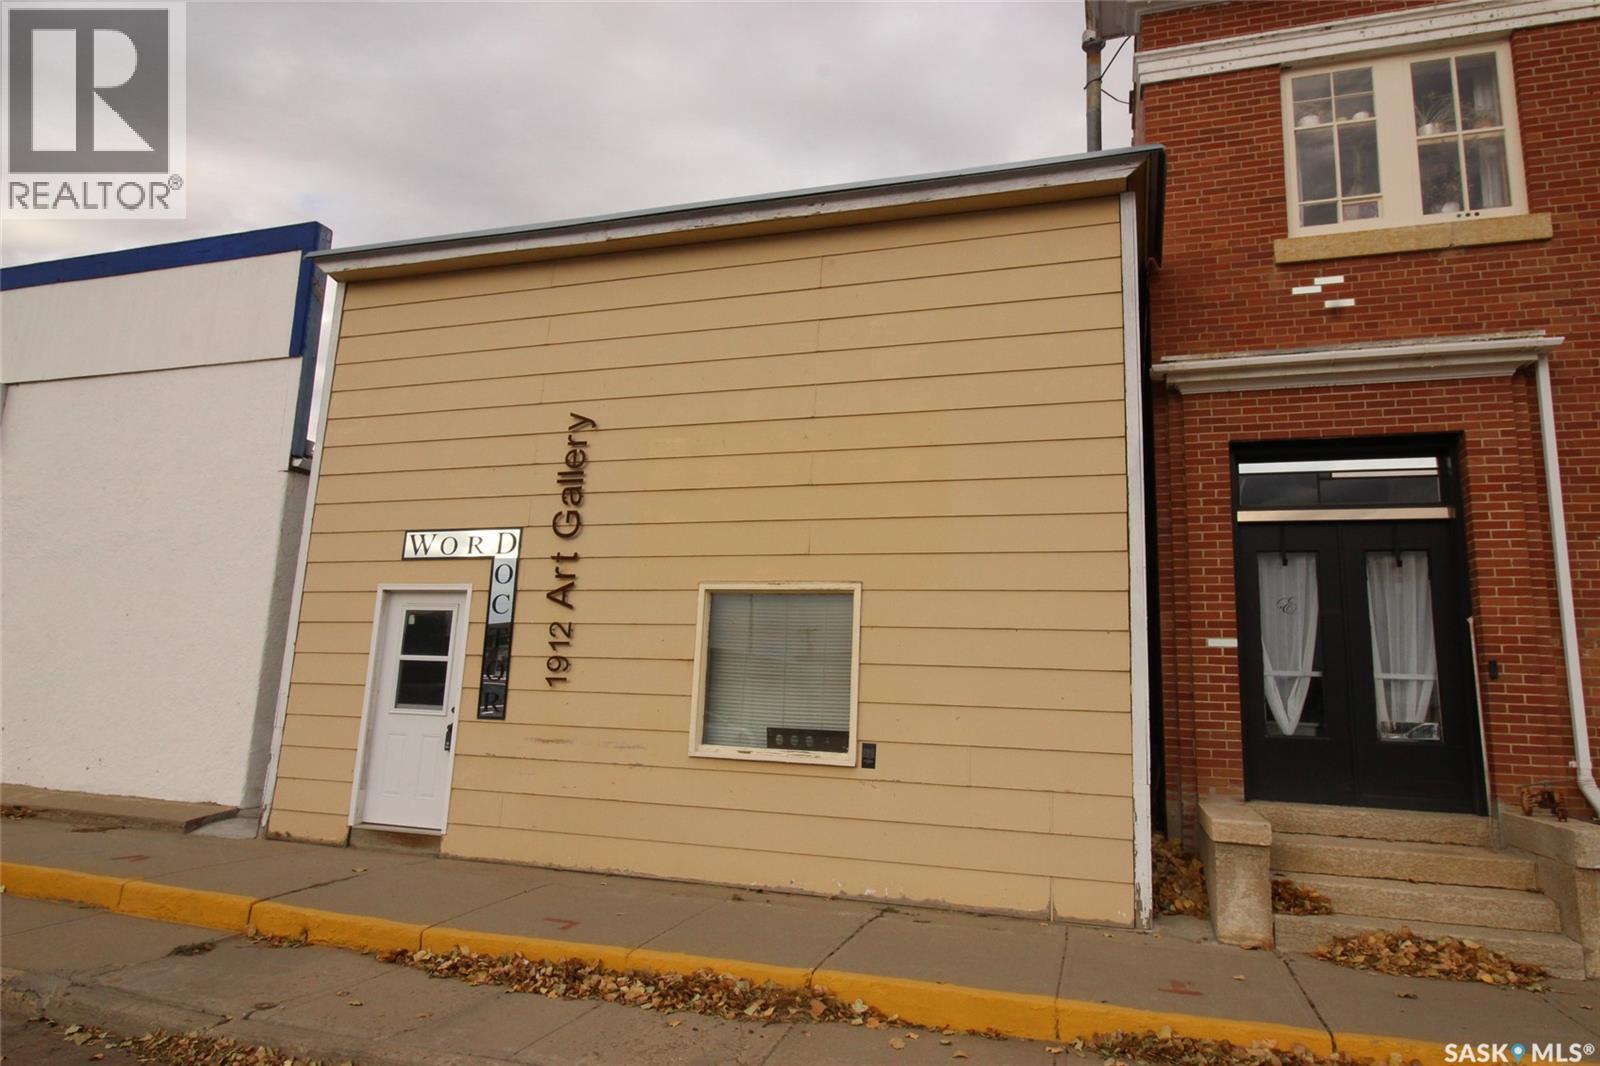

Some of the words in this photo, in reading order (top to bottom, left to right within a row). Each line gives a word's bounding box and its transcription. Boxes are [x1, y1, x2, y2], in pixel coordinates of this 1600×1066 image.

[552, 412, 597, 538] Gallery
[546, 552, 580, 610] Art
[545, 621, 573, 687] 1912
